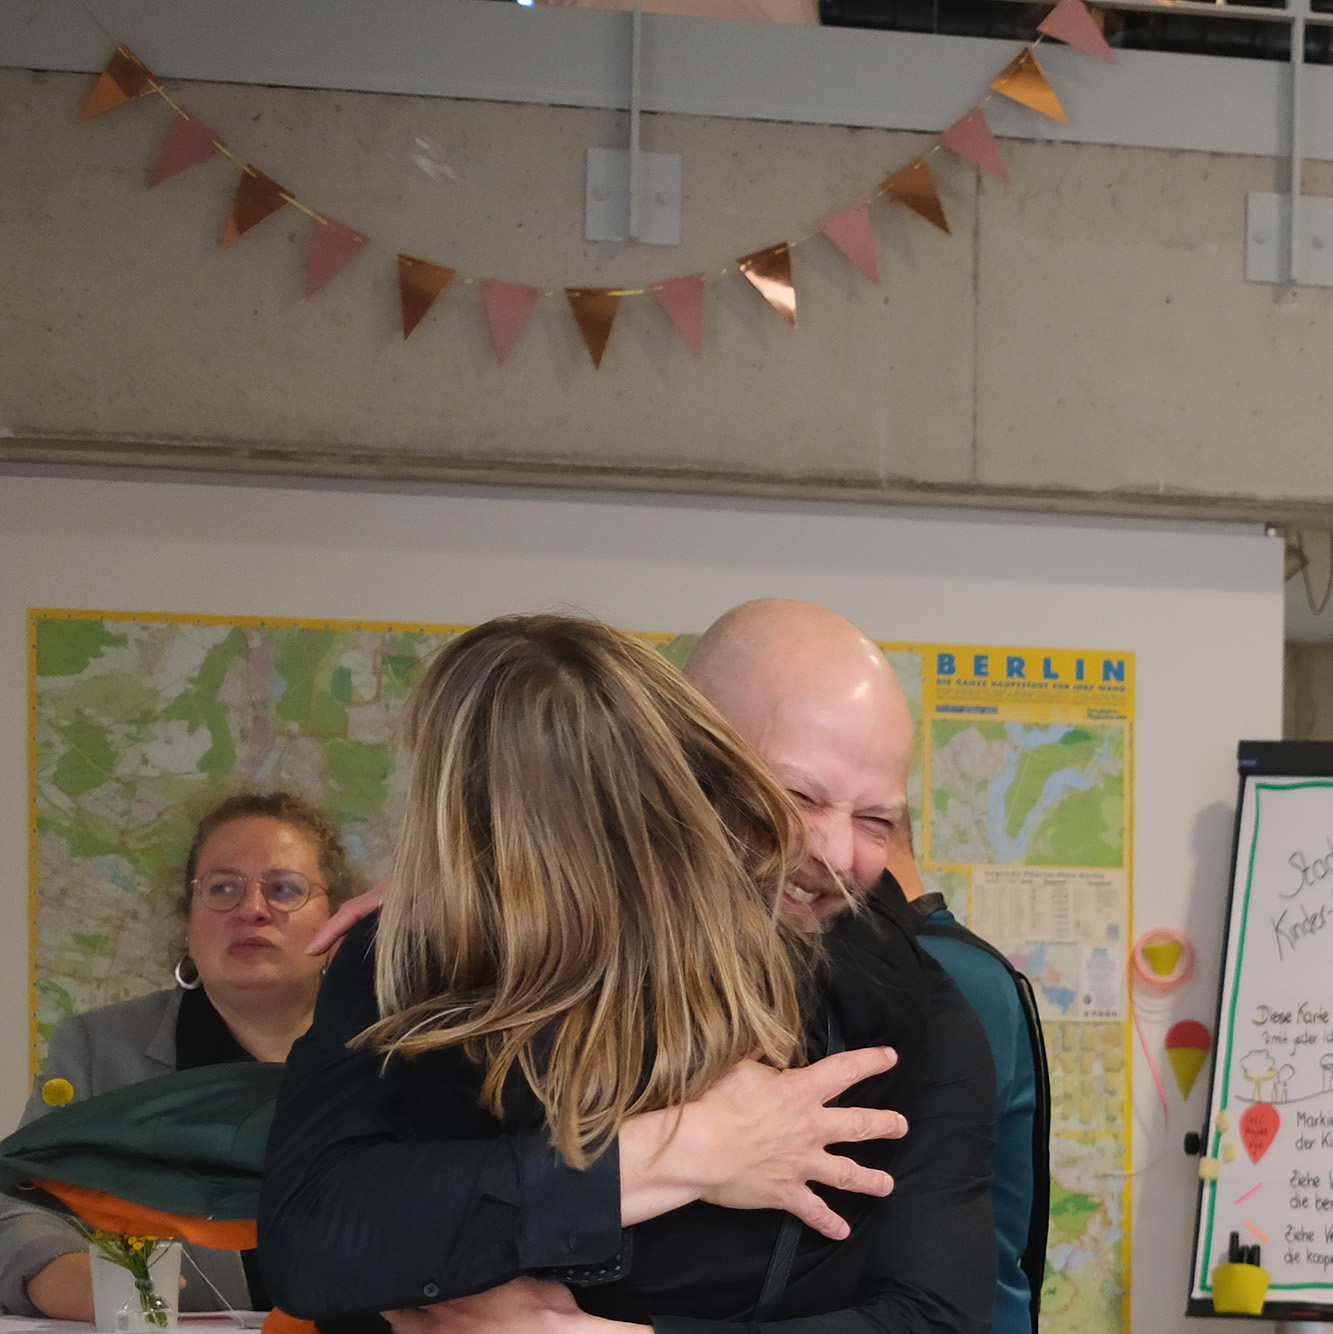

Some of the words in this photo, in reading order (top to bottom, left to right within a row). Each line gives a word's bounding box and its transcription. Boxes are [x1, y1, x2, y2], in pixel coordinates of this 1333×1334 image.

[937, 653, 1125, 682] BERLIN
[1251, 1004, 1292, 1026] Diese
[1297, 1001, 1329, 1024] Karte
[1294, 1131, 1315, 1151] der
[1289, 1169, 1320, 1188] Ziehe
[1289, 1191, 1309, 1209] die
[1284, 1223, 1315, 1243] Ziehe
[1283, 1245, 1301, 1264] die
